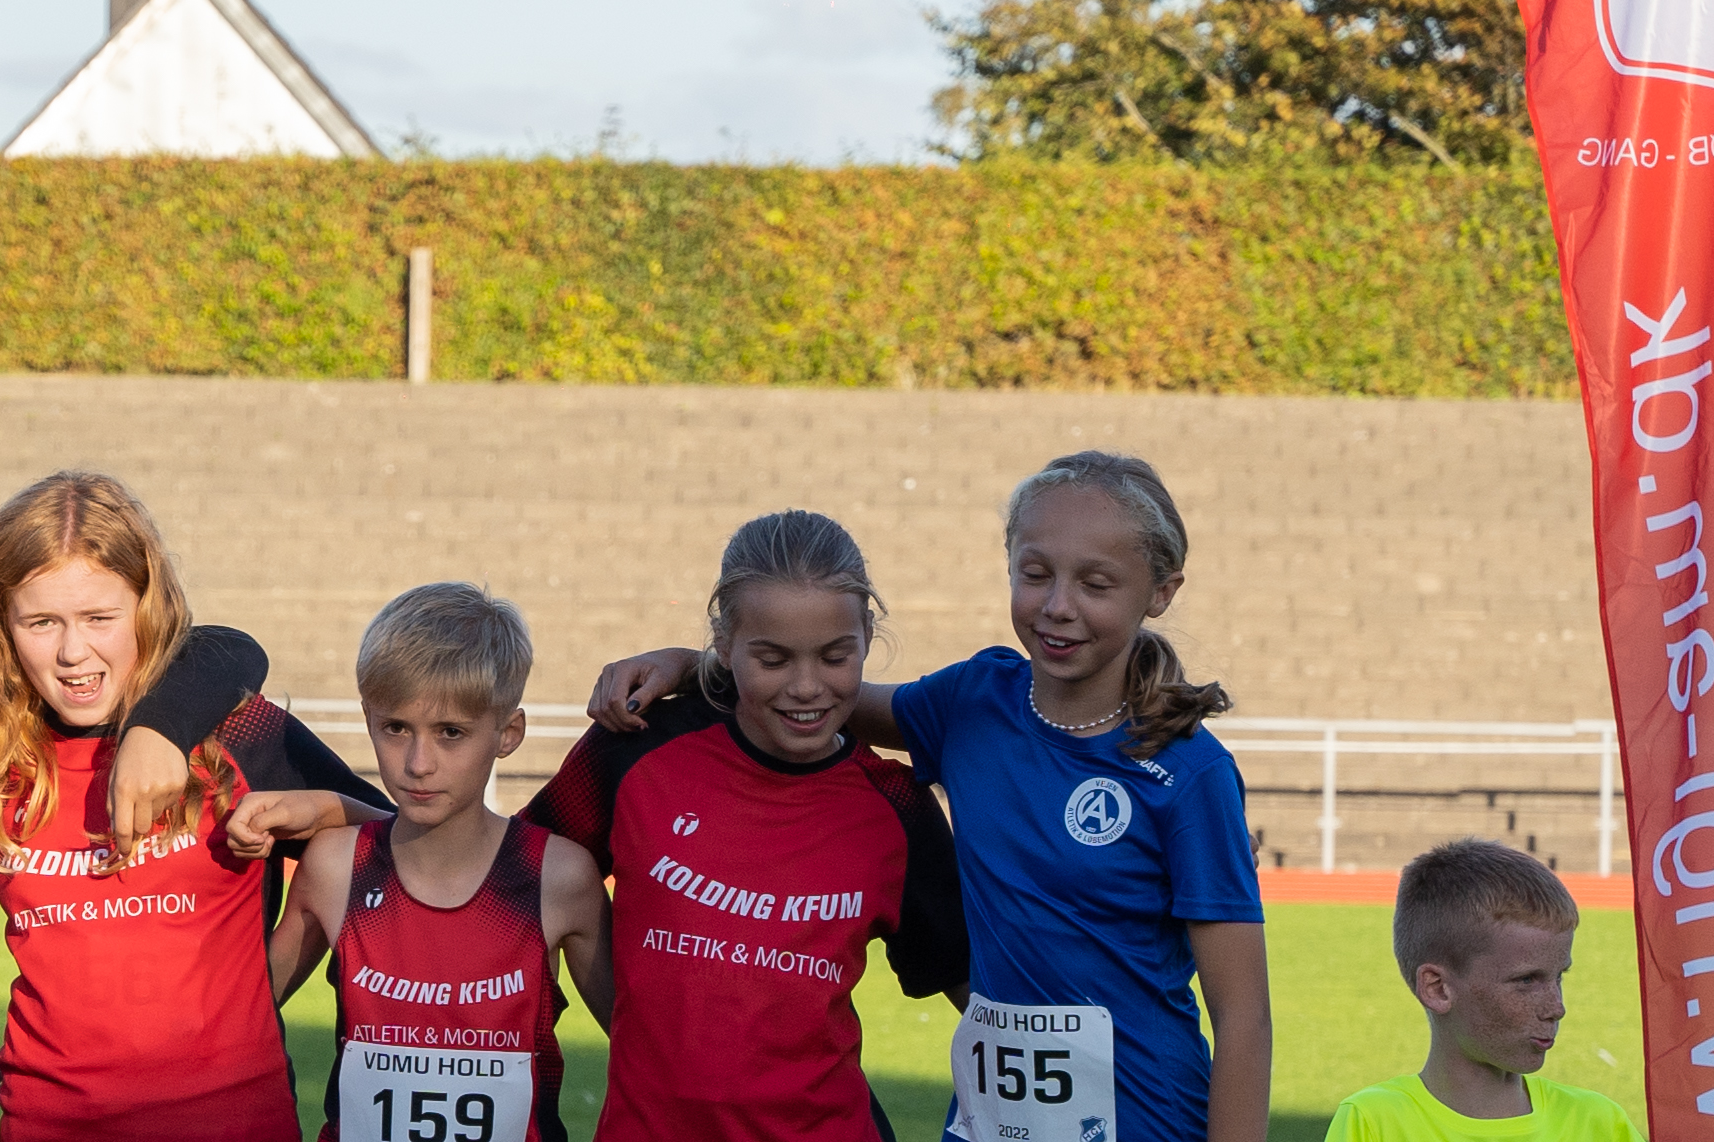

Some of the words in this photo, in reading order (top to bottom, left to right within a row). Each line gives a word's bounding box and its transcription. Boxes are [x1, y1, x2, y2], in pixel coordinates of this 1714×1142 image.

[1, 847, 109, 877] OLDING
[649, 855, 776, 920] KOLDING
[780, 891, 863, 922] KFUM
[14, 902, 76, 931] ATLETIK
[81, 901, 98, 920] &
[104, 893, 197, 919] MOTION
[642, 928, 728, 961] ATLETIK
[730, 943, 749, 964] &
[754, 946, 843, 984] MOTION
[352, 965, 452, 1005] KOLDING
[459, 969, 525, 1005] KFUM
[970, 1003, 1008, 1029] VDMU
[1014, 1013, 1081, 1033] HOLD
[352, 1025, 420, 1044] ATLETIK
[425, 1027, 439, 1044] &
[444, 1028, 521, 1048] MOTION
[364, 1051, 430, 1075] VDMU
[438, 1057, 505, 1078] HOLD
[972, 1040, 1073, 1104] 155
[998, 1124, 1030, 1140] 2022
